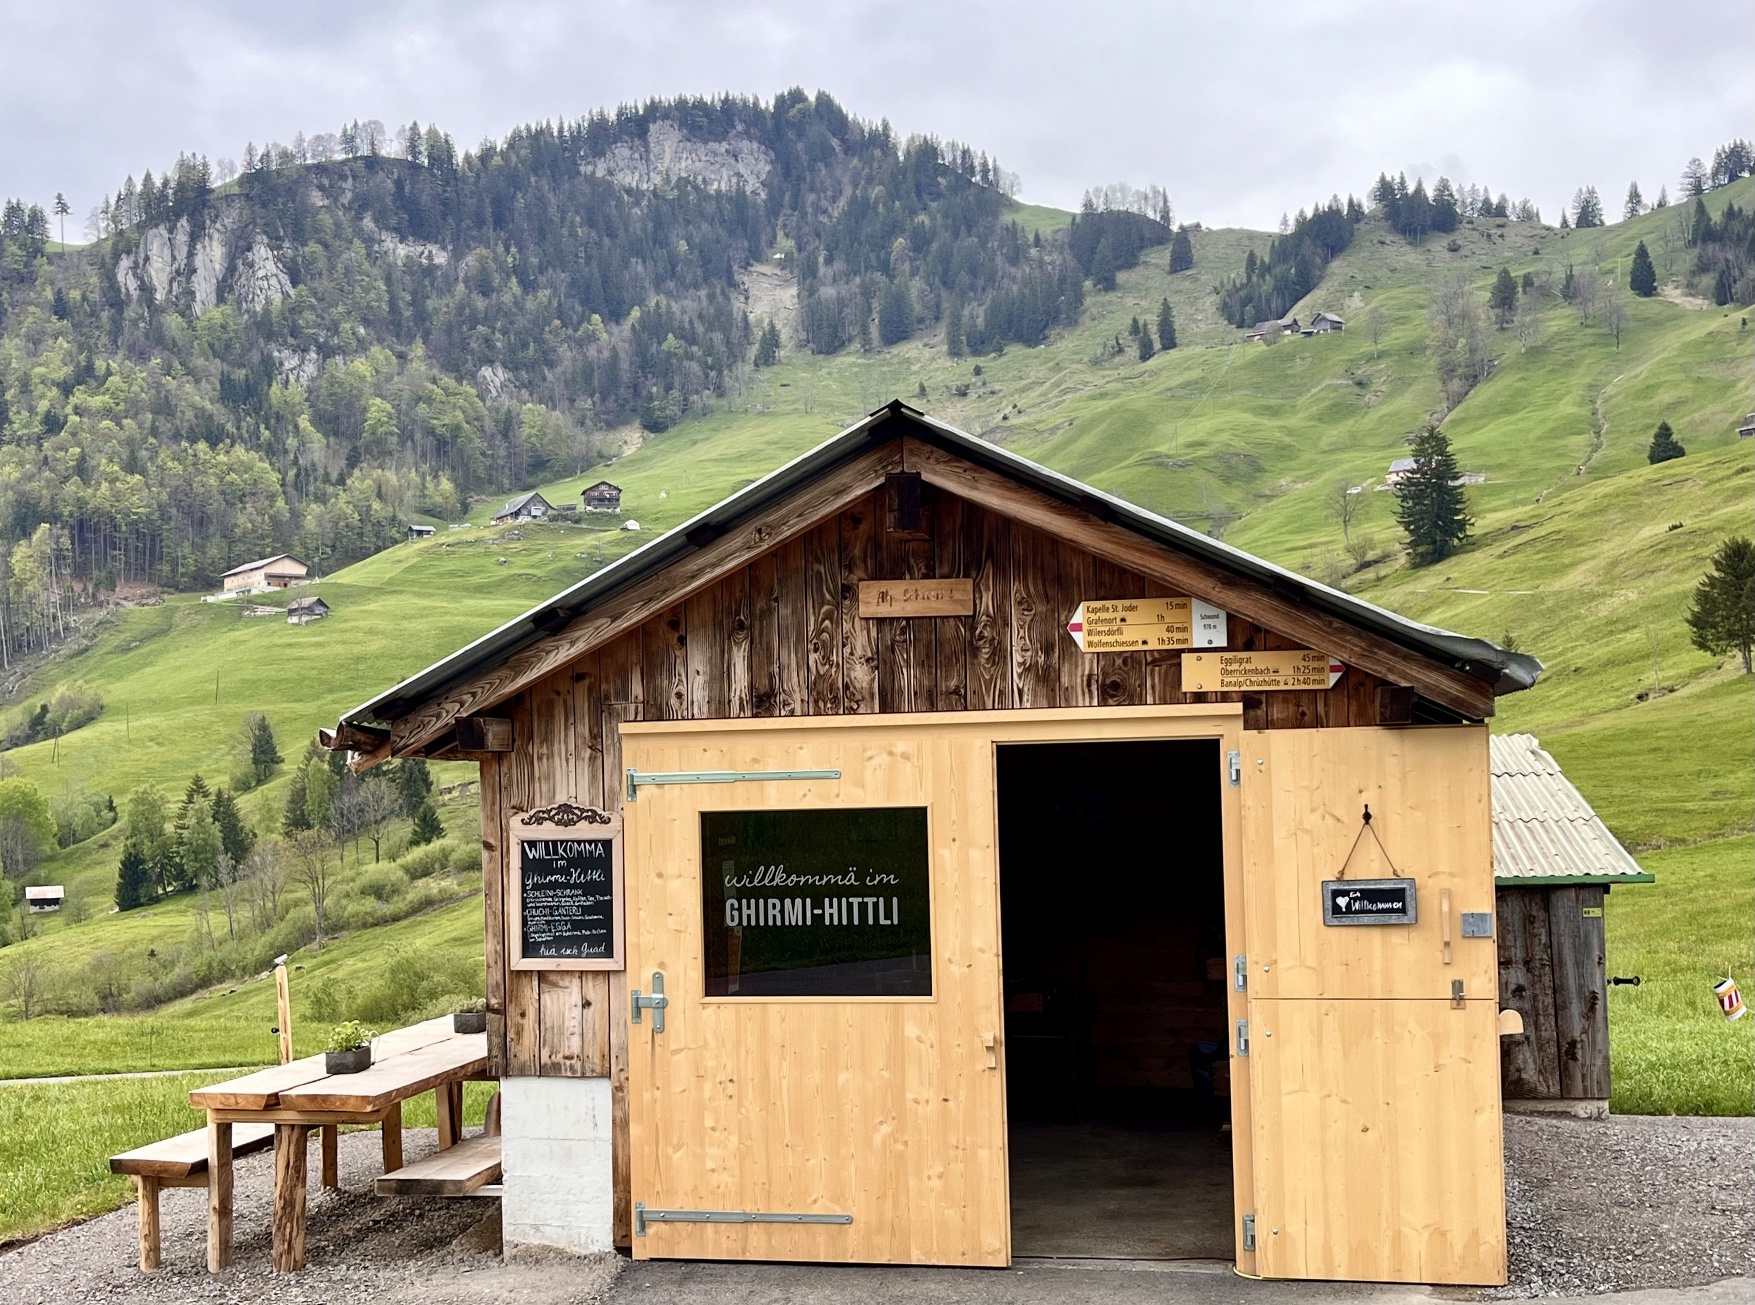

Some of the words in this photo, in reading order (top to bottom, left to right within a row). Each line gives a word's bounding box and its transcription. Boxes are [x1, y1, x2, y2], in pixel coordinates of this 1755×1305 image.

[1087, 604, 1110, 616] Kapelle
[1121, 604, 1138, 612] Joder
[1087, 616, 1117, 625] Grafenort
[1087, 627, 1123, 637] Wilersdörfli
[1087, 639, 1139, 648] Wolfenschiessen
[1220, 656, 1252, 665] Eggiligrat
[1220, 667, 1271, 675] Oberrickenbach
[1220, 678, 1280, 688] Banalp/Chrüzhütte
[524, 841, 605, 859] WILLKOMMÄ
[525, 868, 605, 889] Ghirmi-Hittli
[725, 865, 860, 888] willkommä
[866, 868, 899, 885] im
[1351, 900, 1402, 911] Willkommen
[726, 897, 899, 926] GHIRMI-HITTLI
